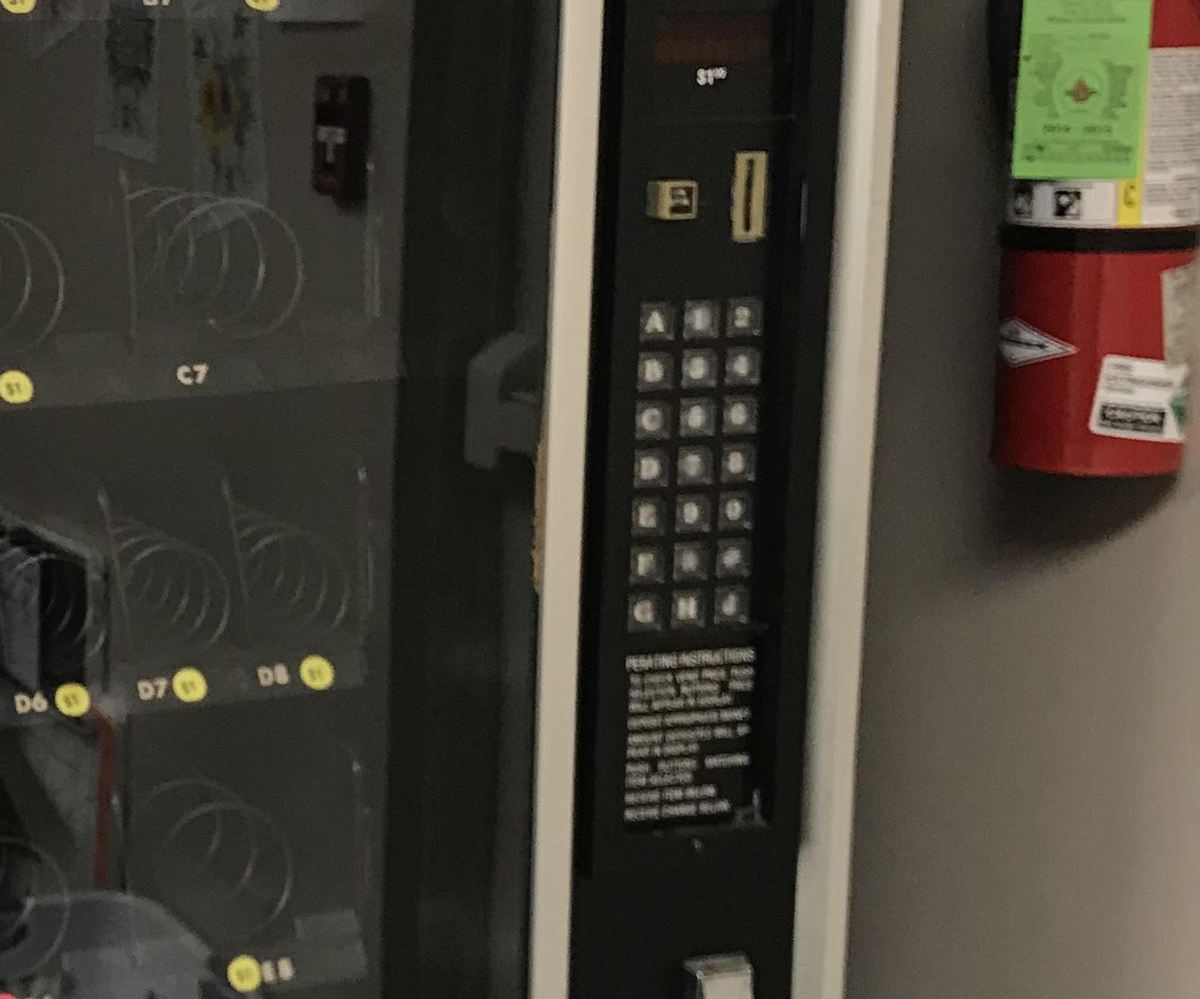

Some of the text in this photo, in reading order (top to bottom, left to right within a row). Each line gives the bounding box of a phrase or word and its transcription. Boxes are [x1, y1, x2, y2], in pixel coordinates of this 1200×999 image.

[644, 310, 665, 334] A
[176, 363, 210, 386] C7
[257, 663, 290, 686] D8
[137, 678, 169, 700] D7
[14, 691, 50, 714] D6
